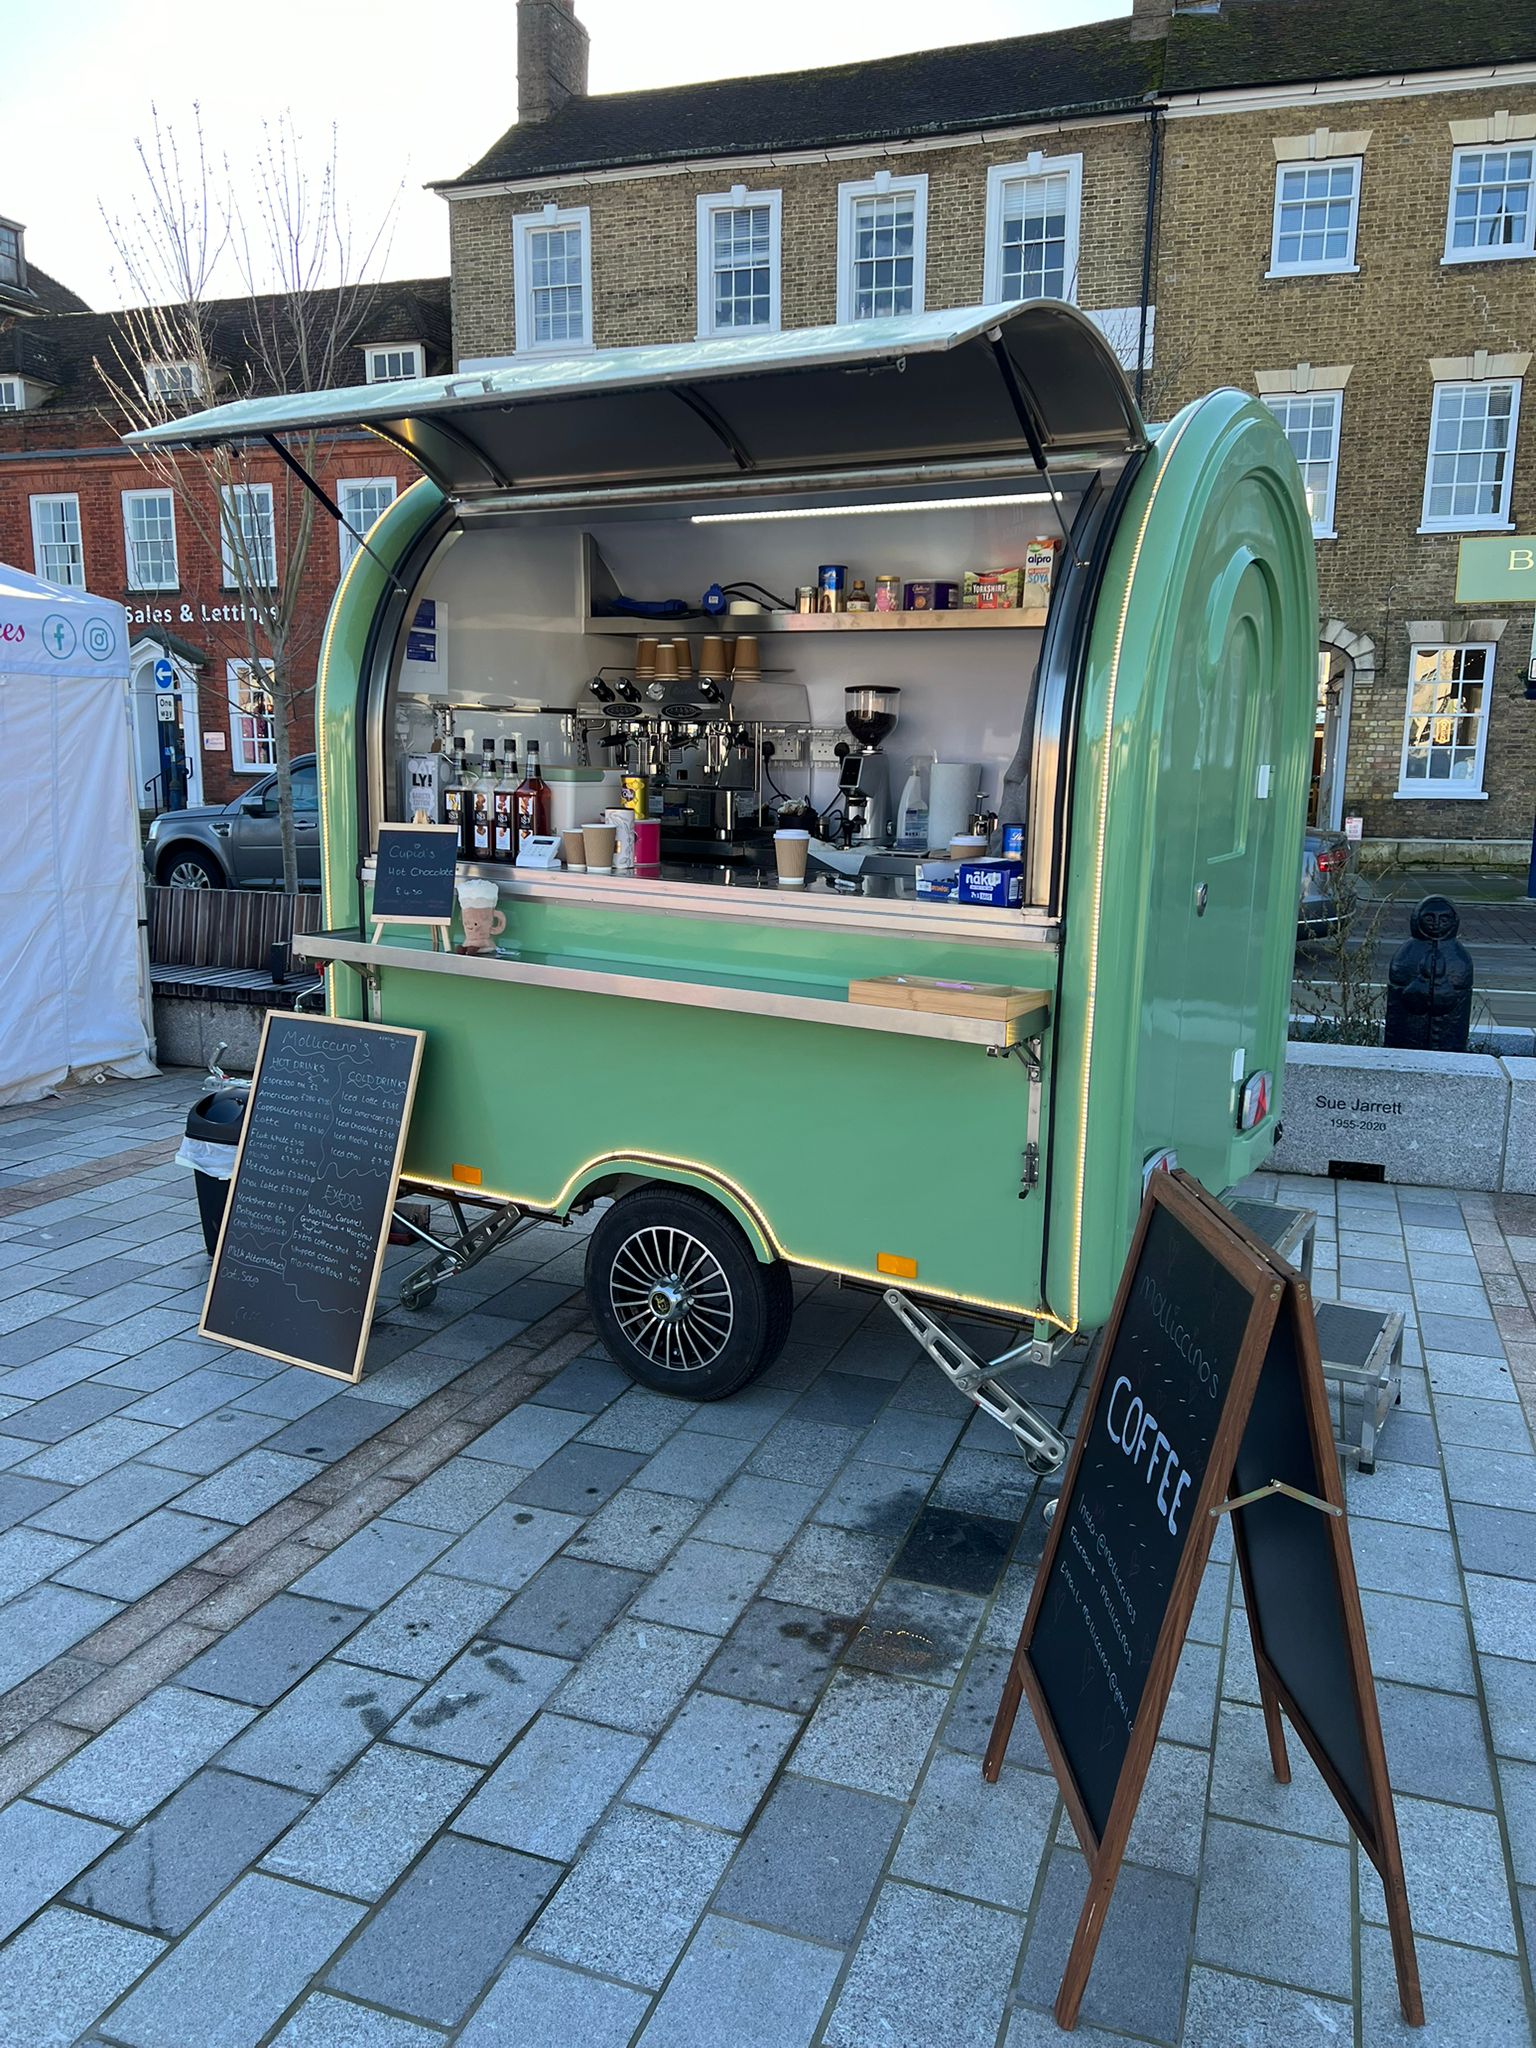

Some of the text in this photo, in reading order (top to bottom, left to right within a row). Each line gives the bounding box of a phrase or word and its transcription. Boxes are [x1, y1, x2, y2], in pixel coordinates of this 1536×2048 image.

[1028, 554, 1052, 566] alpro
[1508, 550, 1534, 570] B
[1028, 574, 1049, 584] SOYA
[972, 584, 1006, 593] YORKSHIRE
[125, 604, 172, 623] Sales
[180, 604, 194, 622] &
[0, 623, 25, 642] es
[160, 698, 172, 707] One
[412, 773, 432, 787] LY!
[389, 845, 436, 859] Cupid's
[410, 867, 454, 877] Chocolate
[272, 1057, 326, 1073] HOT DRINKS
[263, 1076, 295, 1087] Espresso
[348, 1071, 374, 1084] COLD
[259, 1090, 299, 1102] Americano
[1315, 1095, 1402, 1114] Sue Jarrett
[1331, 1119, 1386, 1131] 1955-2020
[324, 1184, 362, 1205] Extras
[1106, 1375, 1192, 1536] COFFEE
